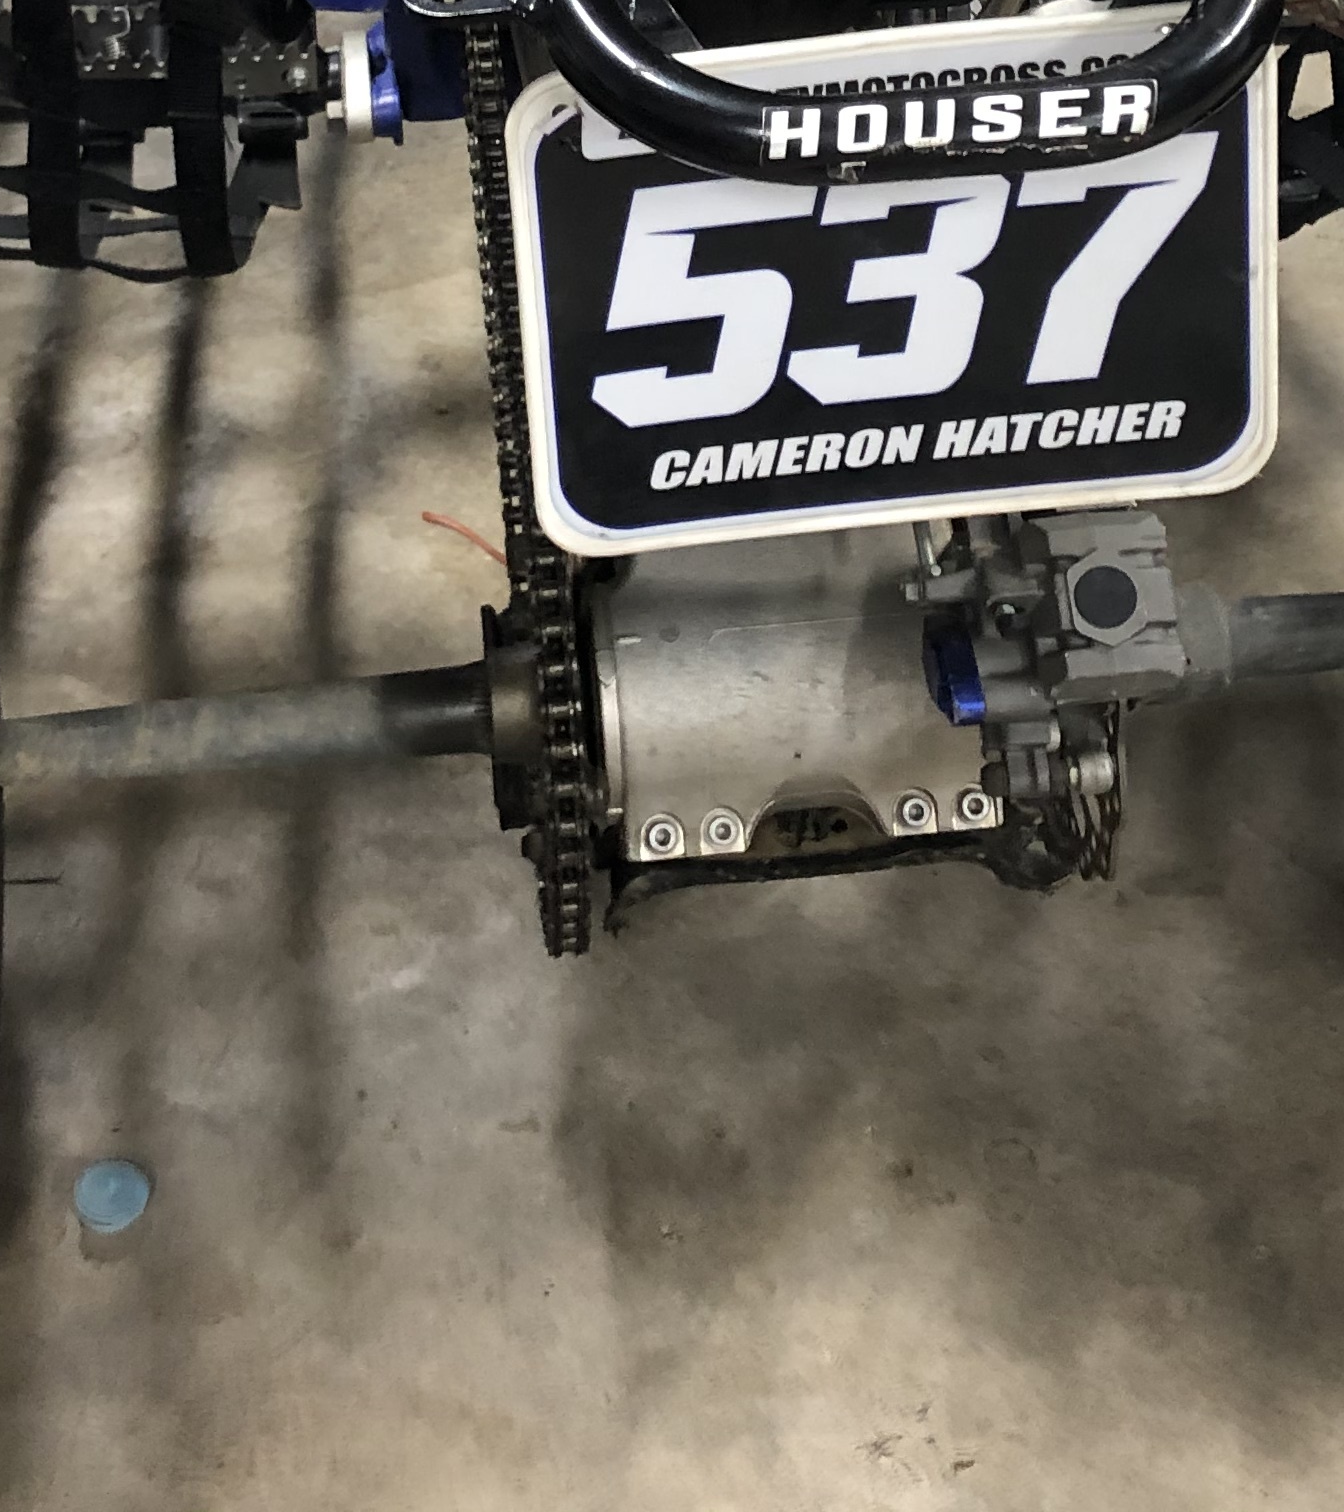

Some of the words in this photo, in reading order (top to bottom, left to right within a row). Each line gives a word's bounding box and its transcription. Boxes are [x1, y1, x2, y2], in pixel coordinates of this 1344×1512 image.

[769, 84, 1155, 161] HOUSER
[591, 131, 1219, 429] 537
[649, 423, 925, 491] CAMERON
[931, 399, 1188, 469] HATCHER
